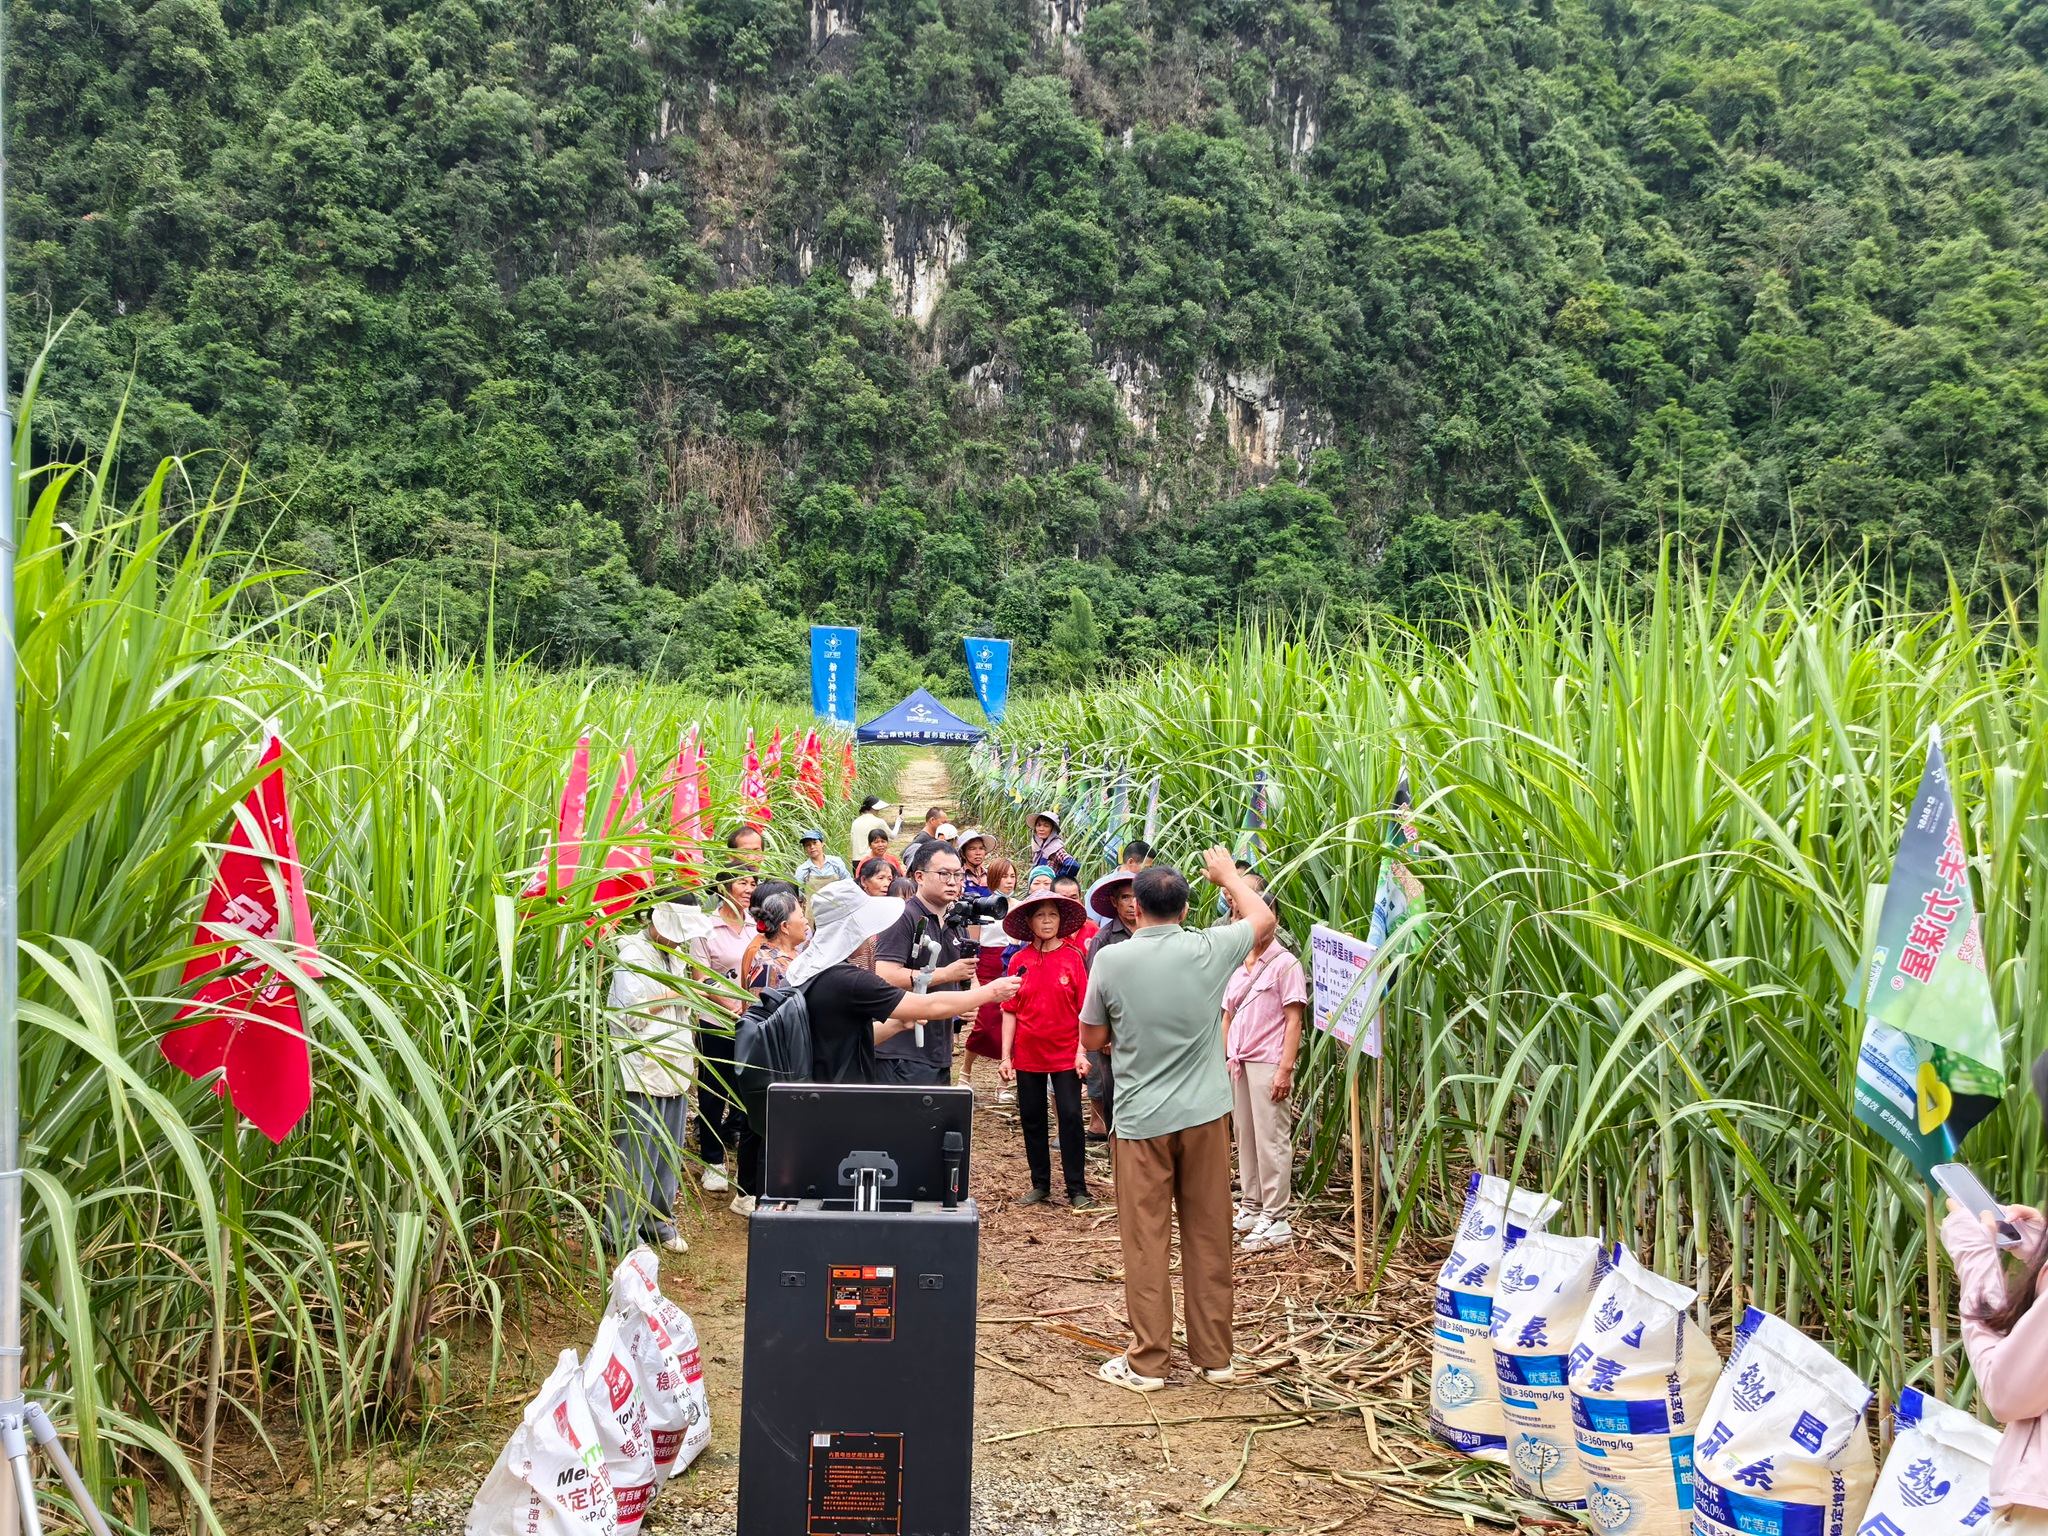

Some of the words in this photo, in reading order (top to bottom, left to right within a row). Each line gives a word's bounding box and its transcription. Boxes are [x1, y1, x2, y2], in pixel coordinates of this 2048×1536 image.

[1461, 1307, 1488, 1324] 优等品
[1528, 1371, 1561, 1384] 优等品
[1595, 1415, 1629, 1431] 优等品
[1739, 1515, 1780, 1536] 优等品
